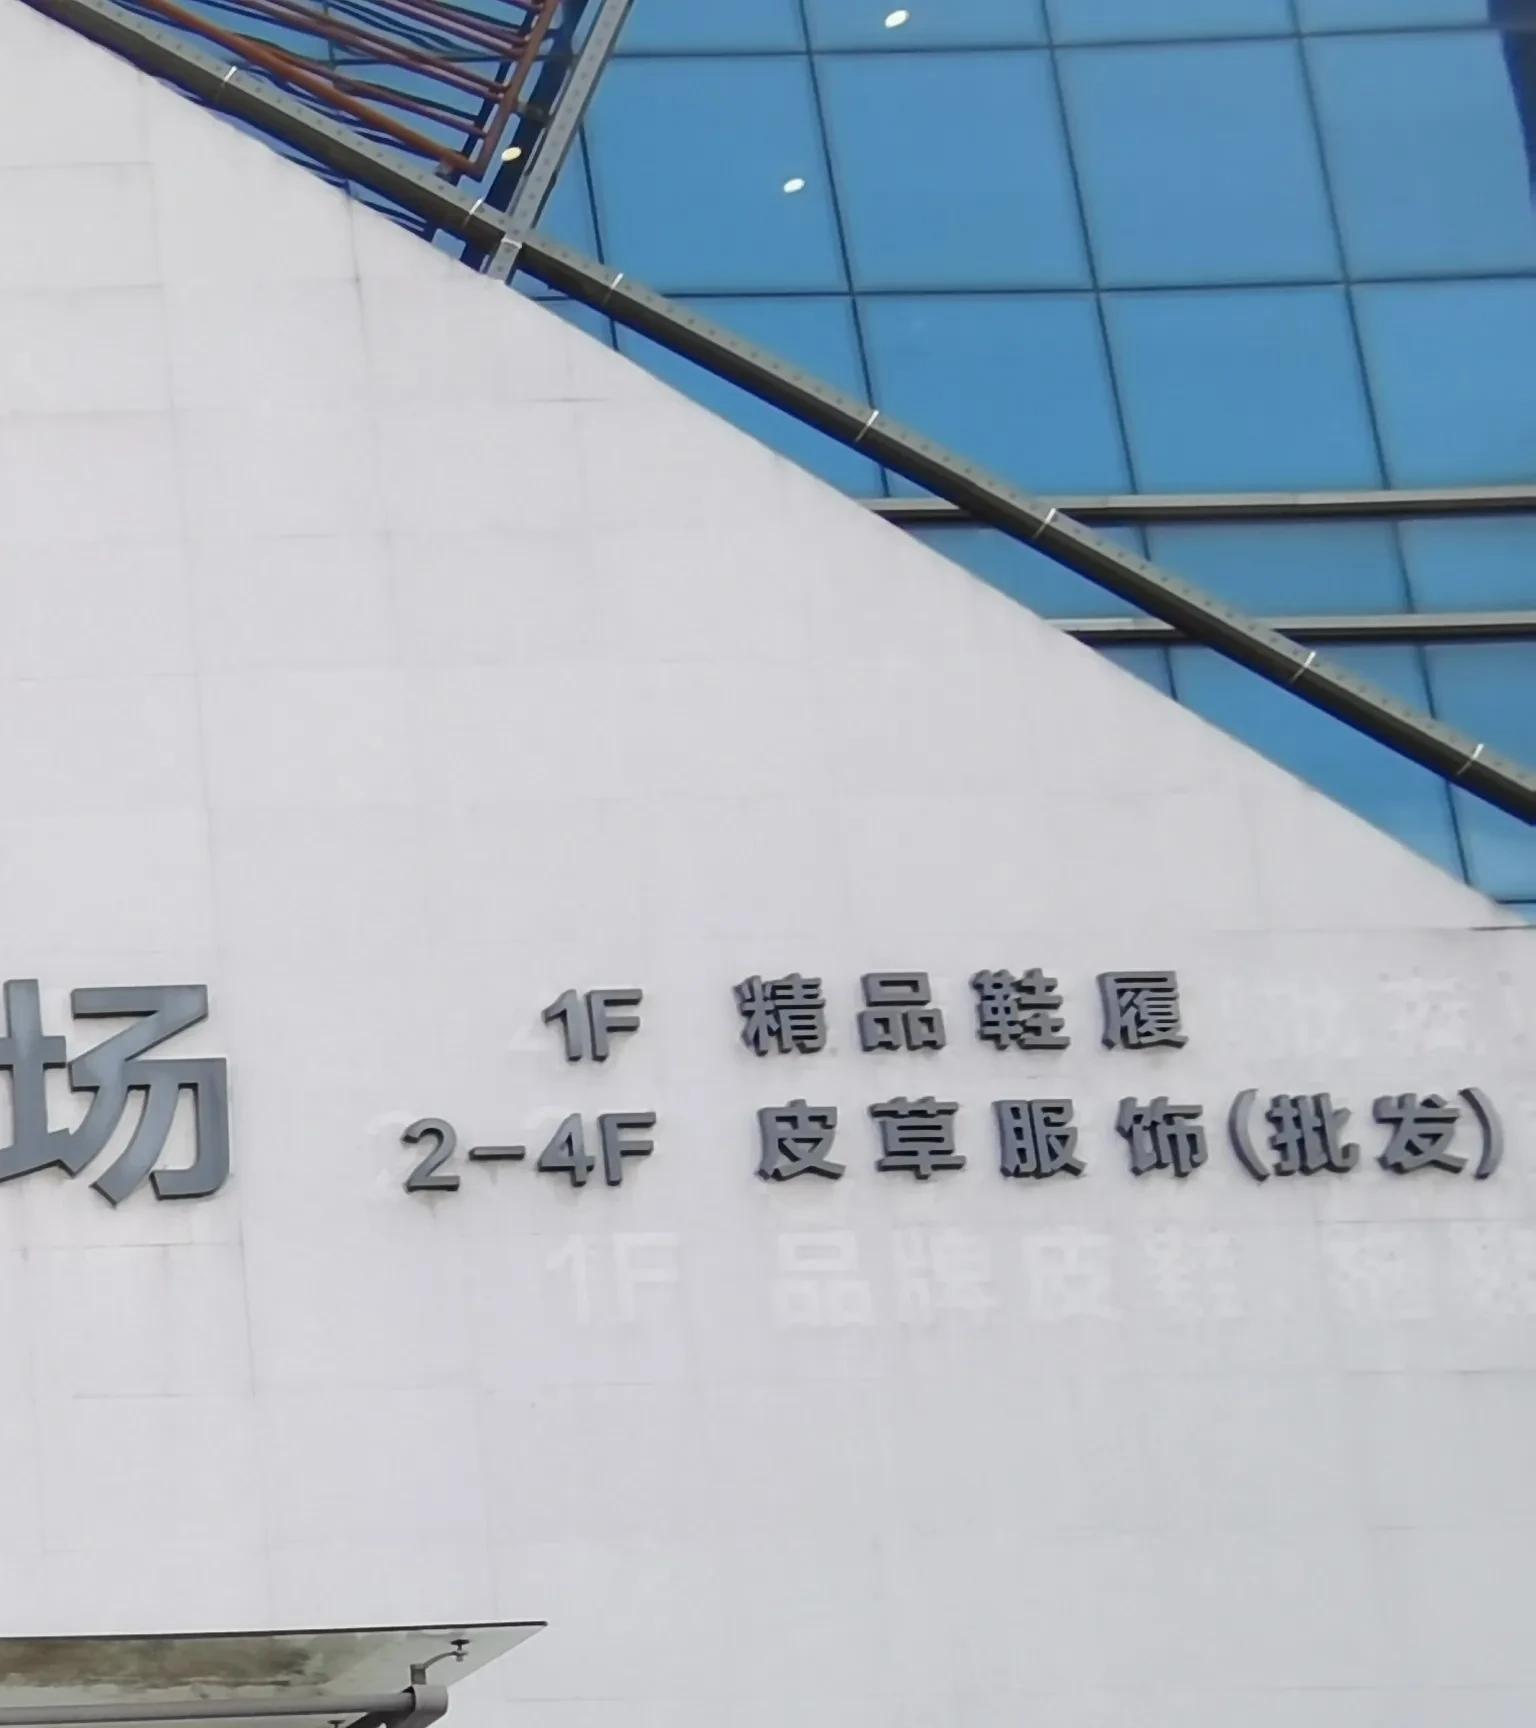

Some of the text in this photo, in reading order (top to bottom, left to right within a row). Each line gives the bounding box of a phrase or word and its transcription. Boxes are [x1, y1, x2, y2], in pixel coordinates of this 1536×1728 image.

[542, 988, 643, 1063] 1F
[732, 968, 1190, 1058] 精品鞋履
[400, 1111, 658, 1194] 2-4F
